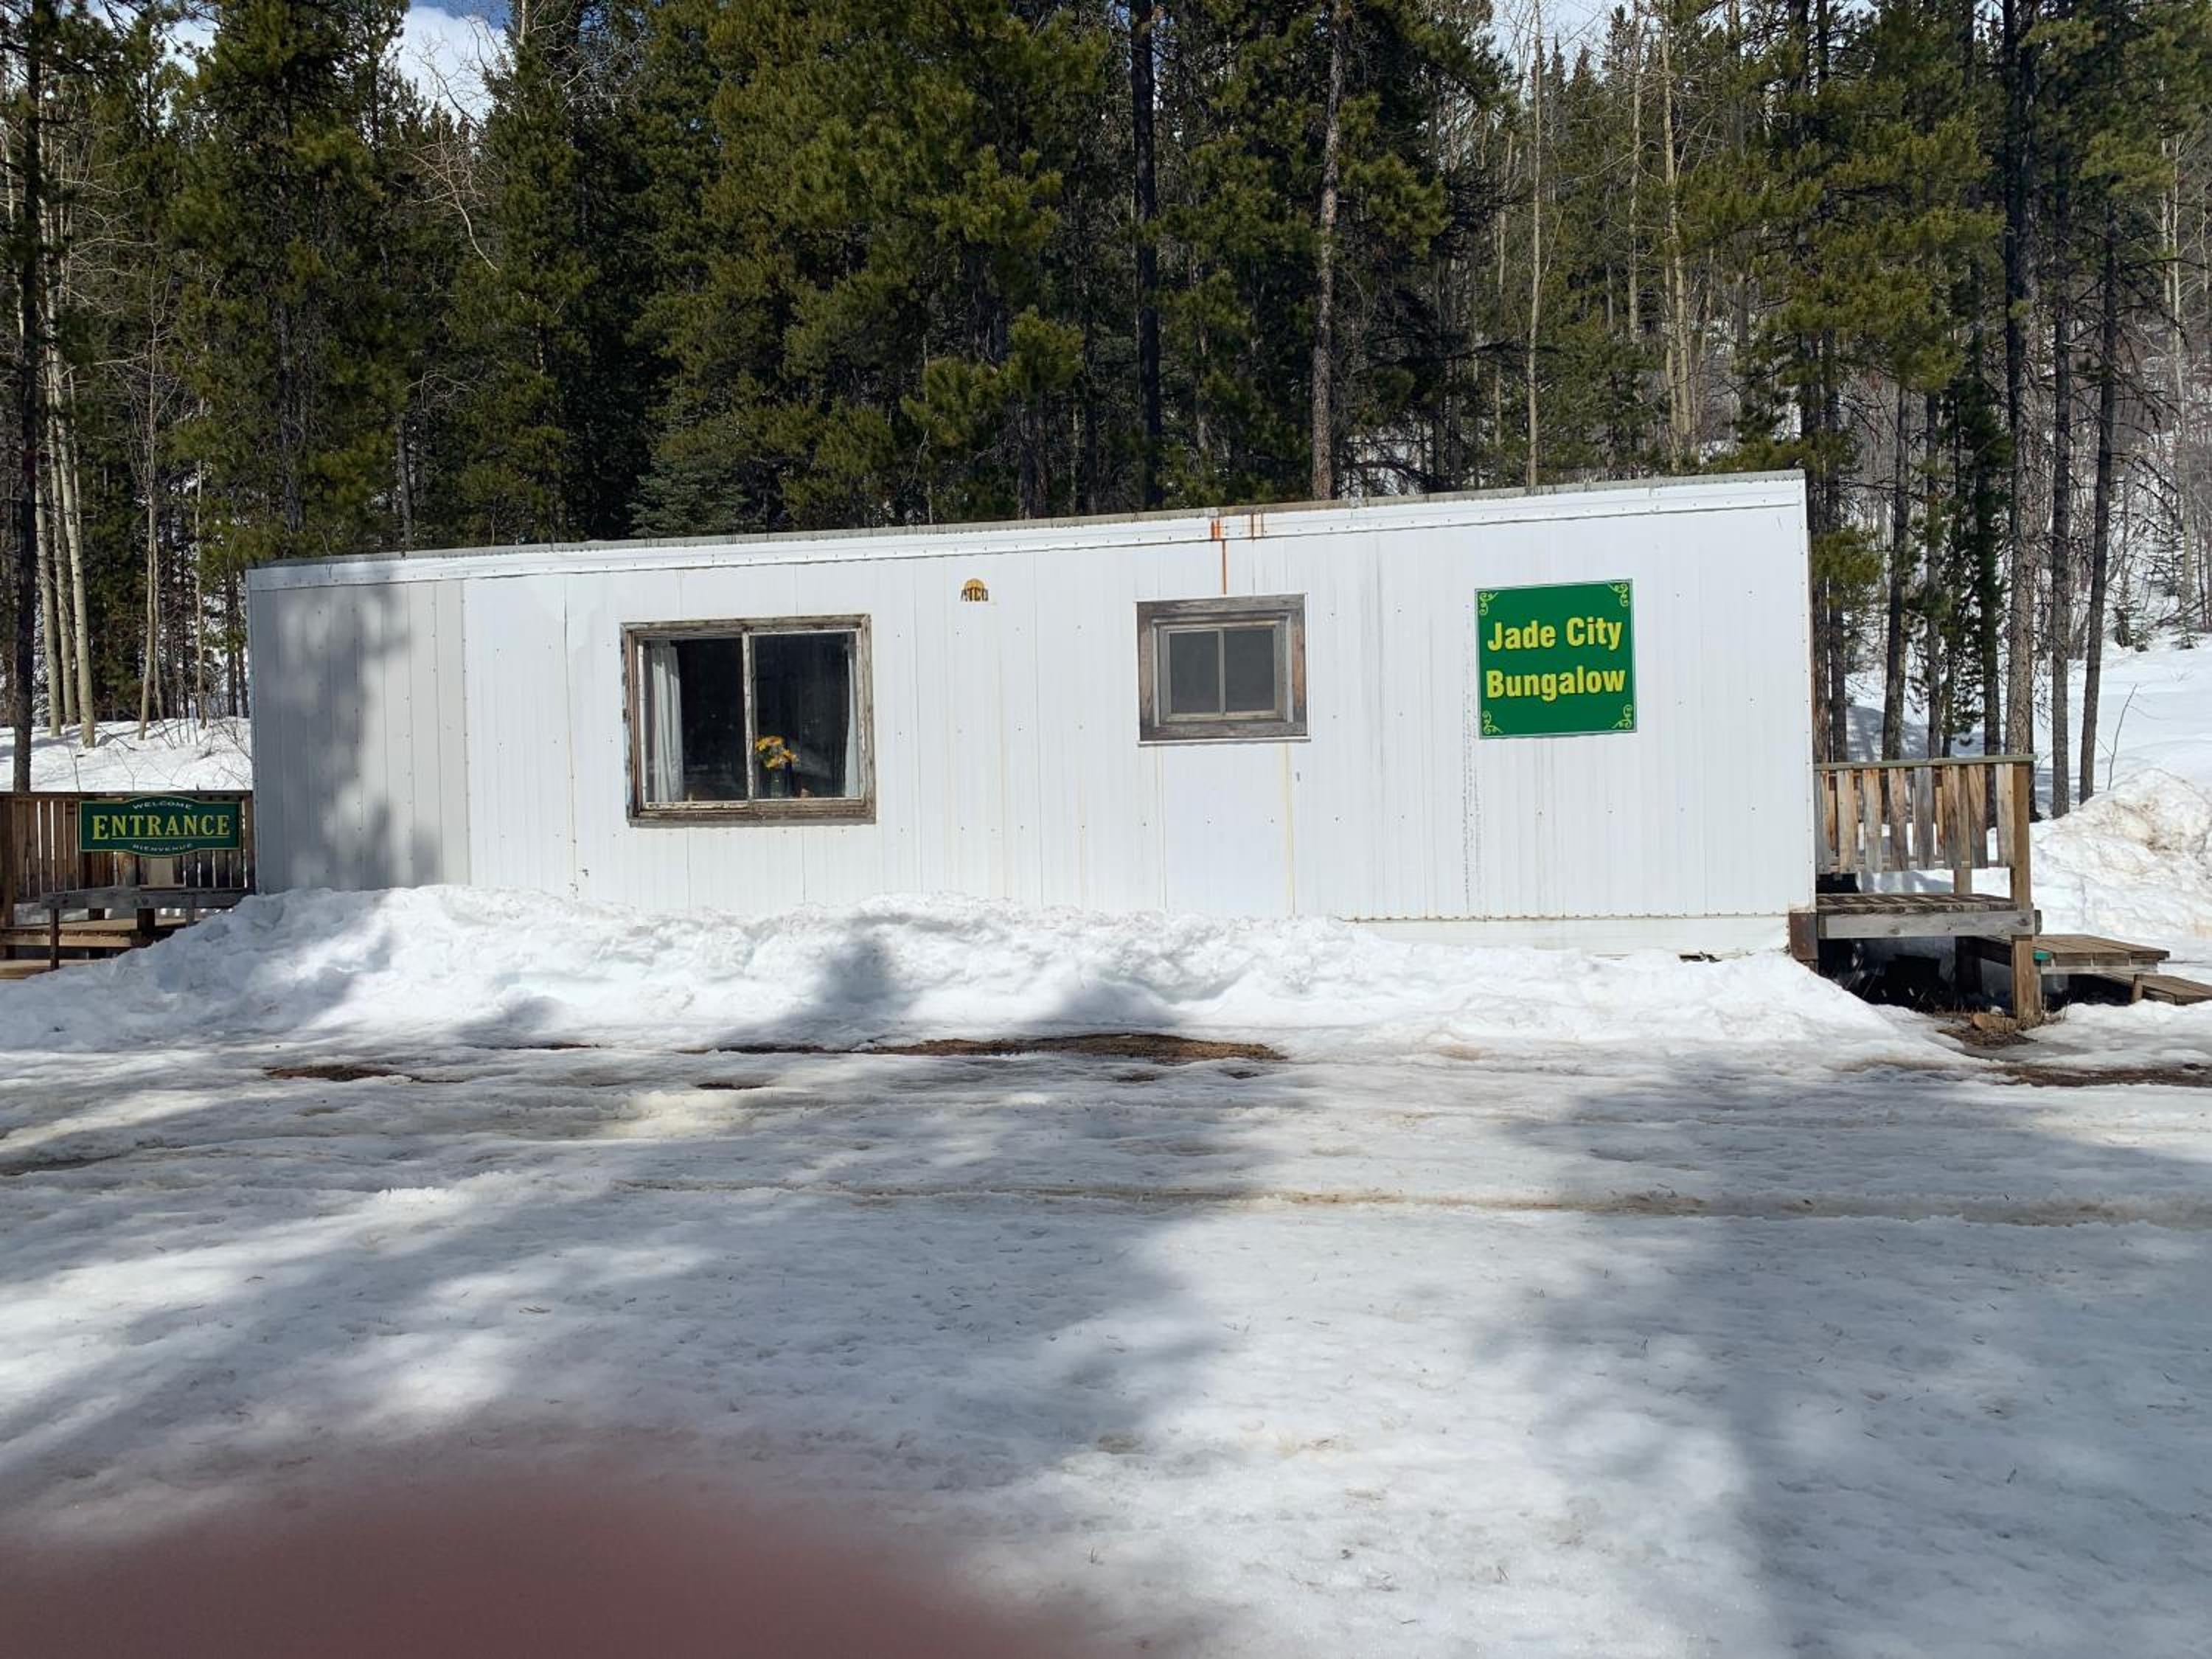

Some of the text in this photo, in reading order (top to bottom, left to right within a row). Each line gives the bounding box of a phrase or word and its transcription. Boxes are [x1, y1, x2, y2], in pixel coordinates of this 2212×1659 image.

[1487, 616, 1622, 650] Jade City
[1486, 665, 1626, 702] Bungalow
[132, 799, 193, 810] WELCOME
[92, 815, 230, 840] ENTRANCE
